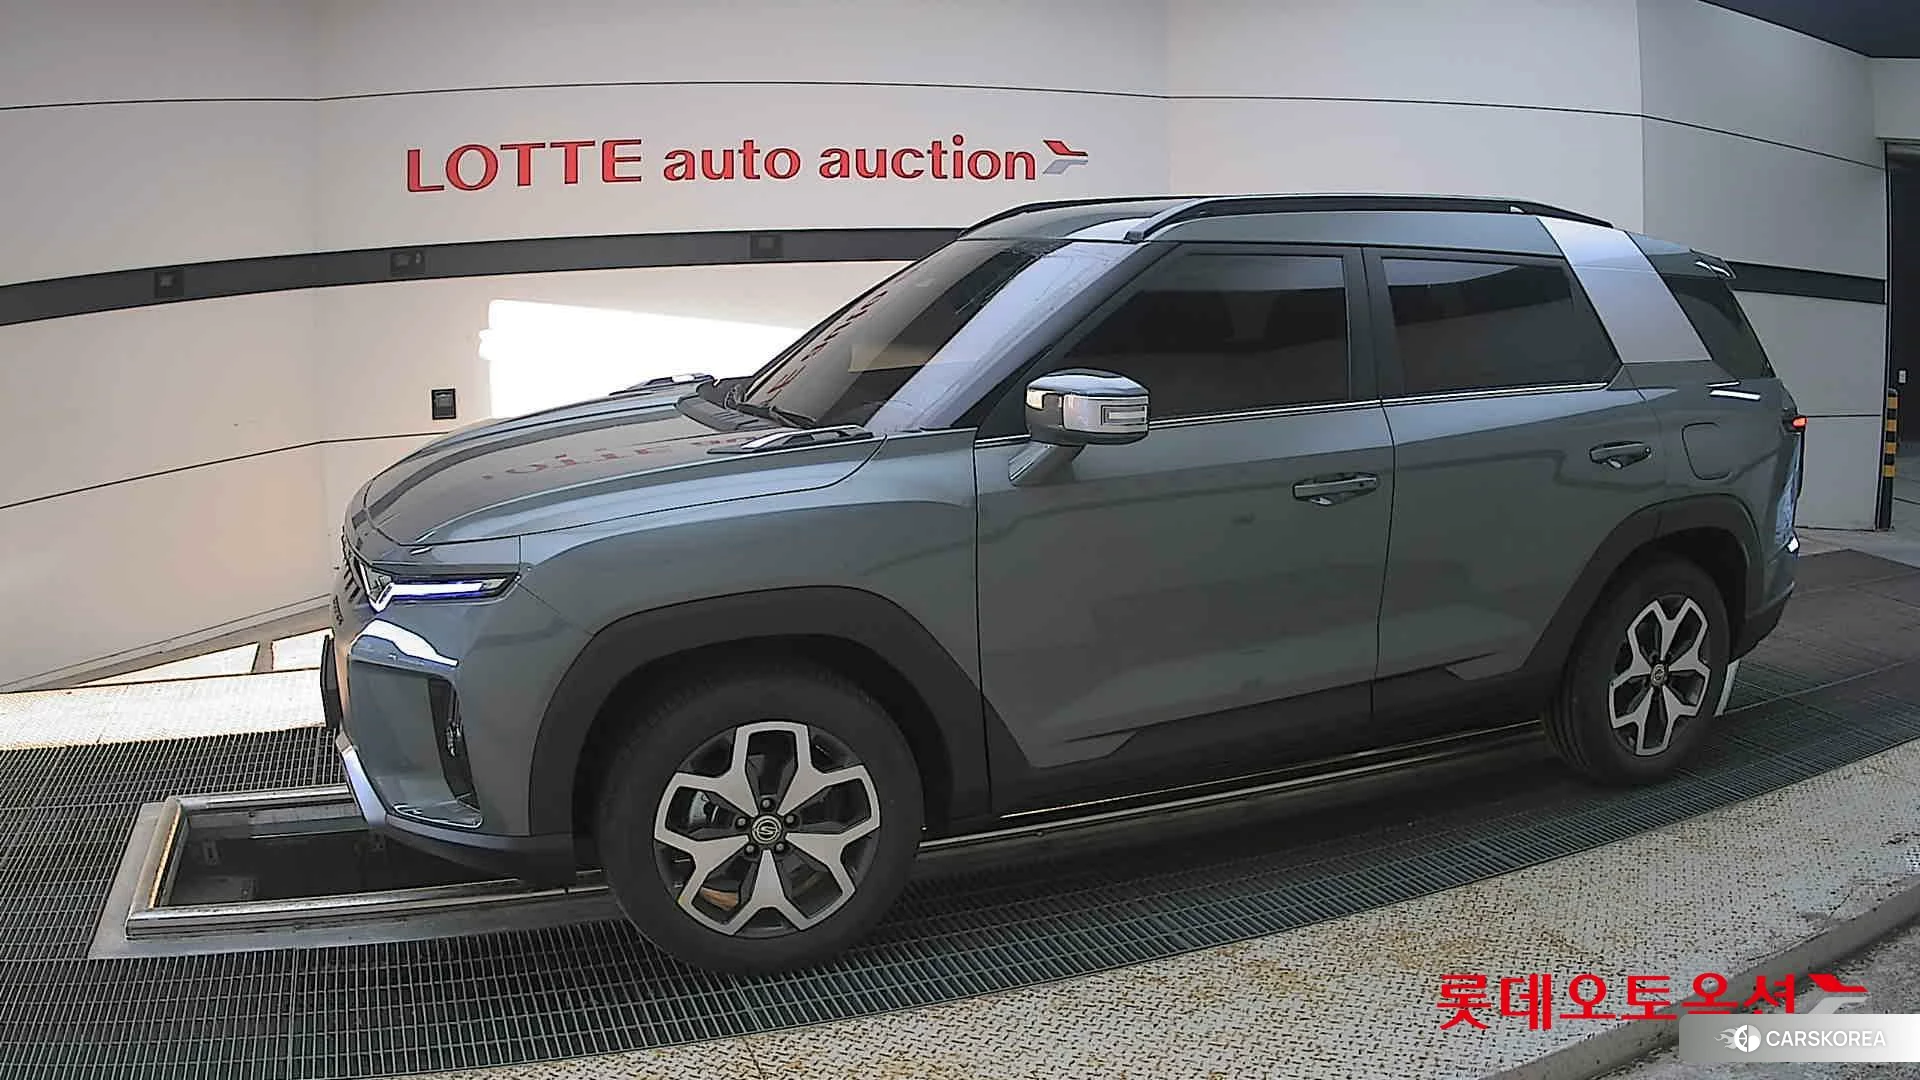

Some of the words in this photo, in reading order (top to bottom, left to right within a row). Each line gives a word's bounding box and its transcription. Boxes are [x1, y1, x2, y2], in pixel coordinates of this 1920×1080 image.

[407, 139, 642, 192] LOTTE
[663, 139, 801, 181] auto
[819, 134, 1037, 180] auction
